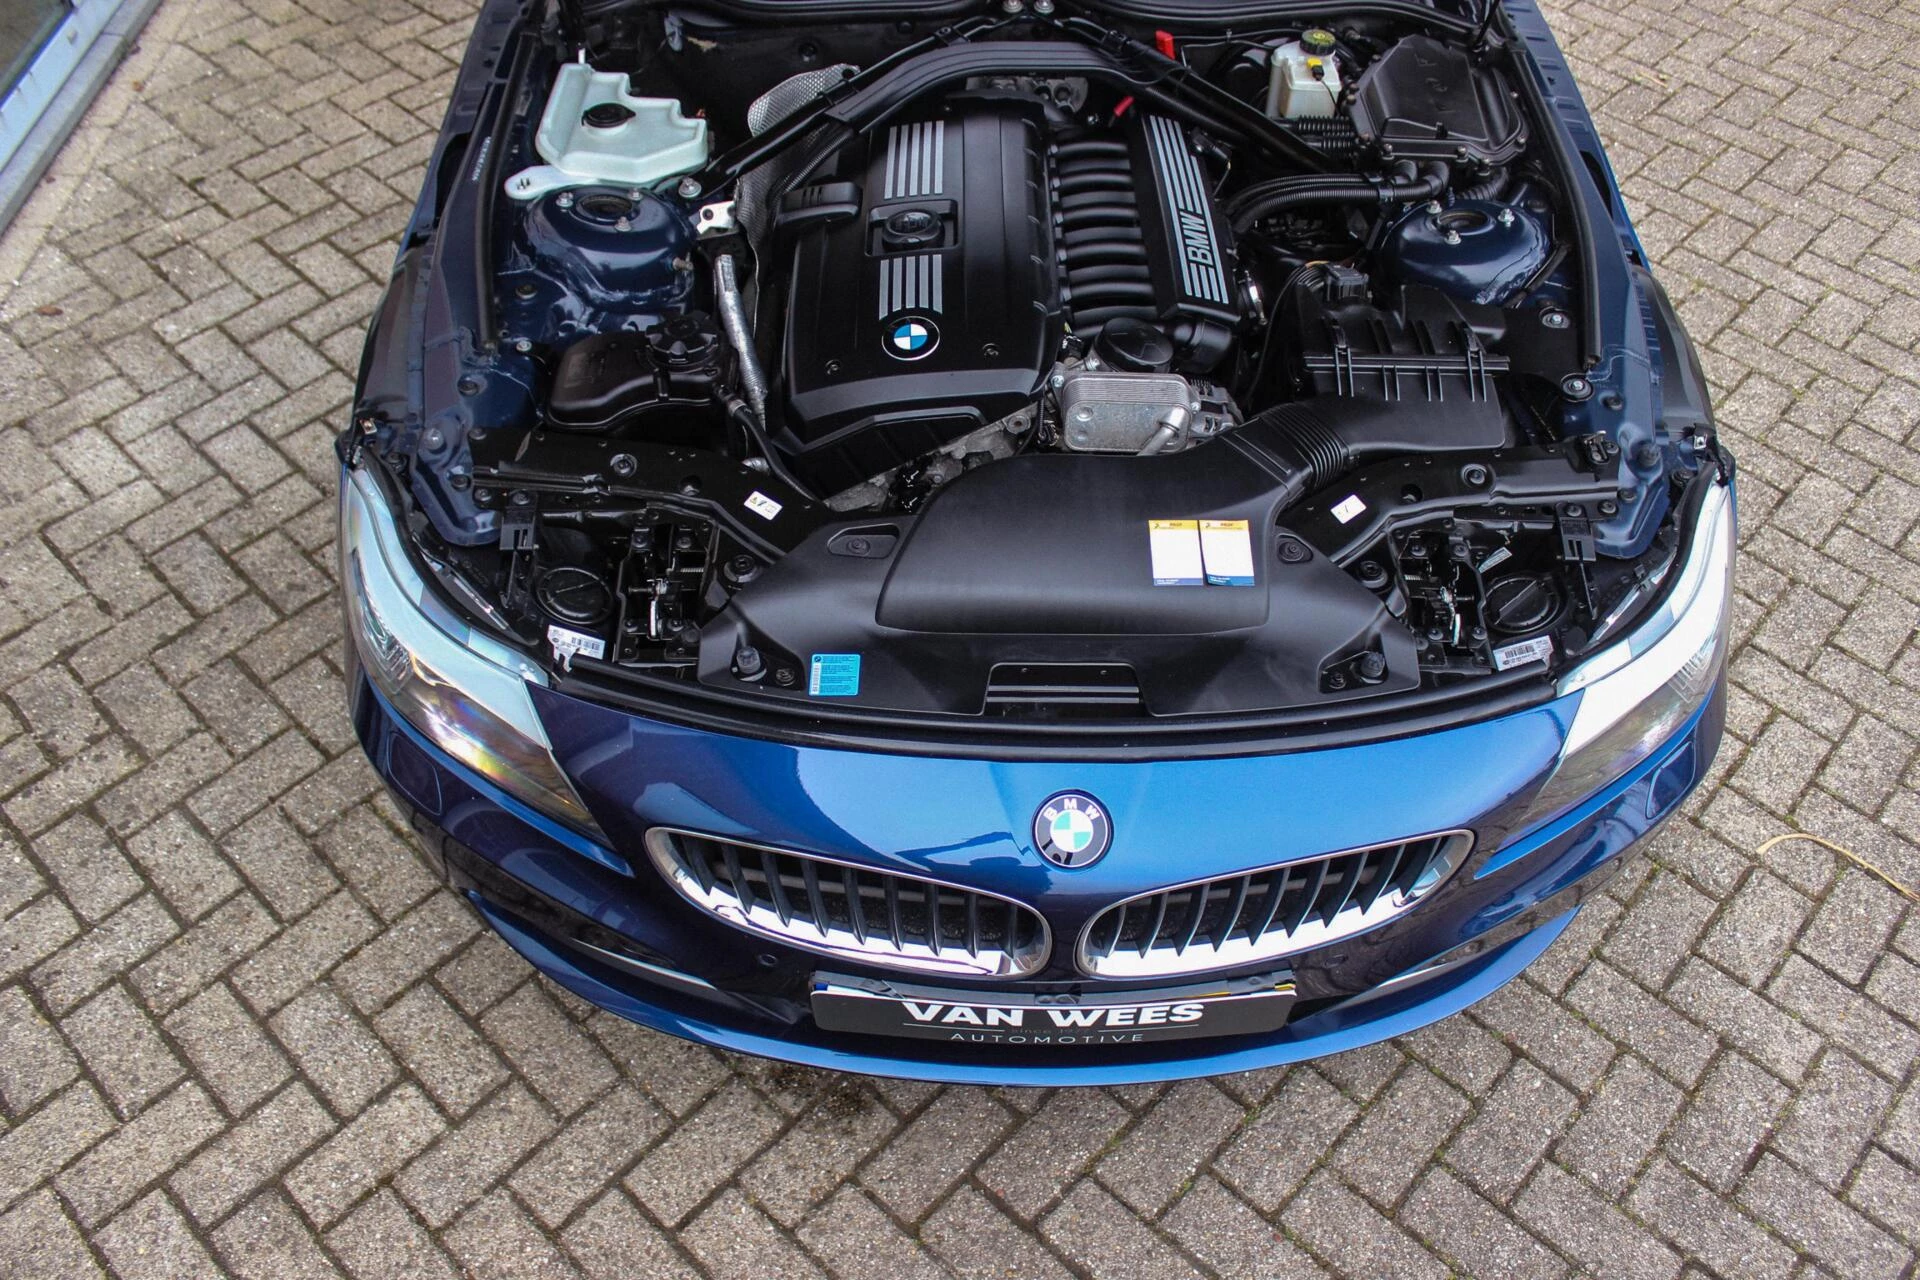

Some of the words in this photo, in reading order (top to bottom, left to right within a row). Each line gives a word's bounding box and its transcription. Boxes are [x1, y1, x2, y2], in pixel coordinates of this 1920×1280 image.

[1179, 211, 1214, 266] BMW
[1043, 798, 1101, 822] BMW
[902, 1001, 1024, 1027] VAN
[1047, 1003, 1204, 1028] WEES
[951, 1033, 1144, 1044] AUTOMOTIVE
